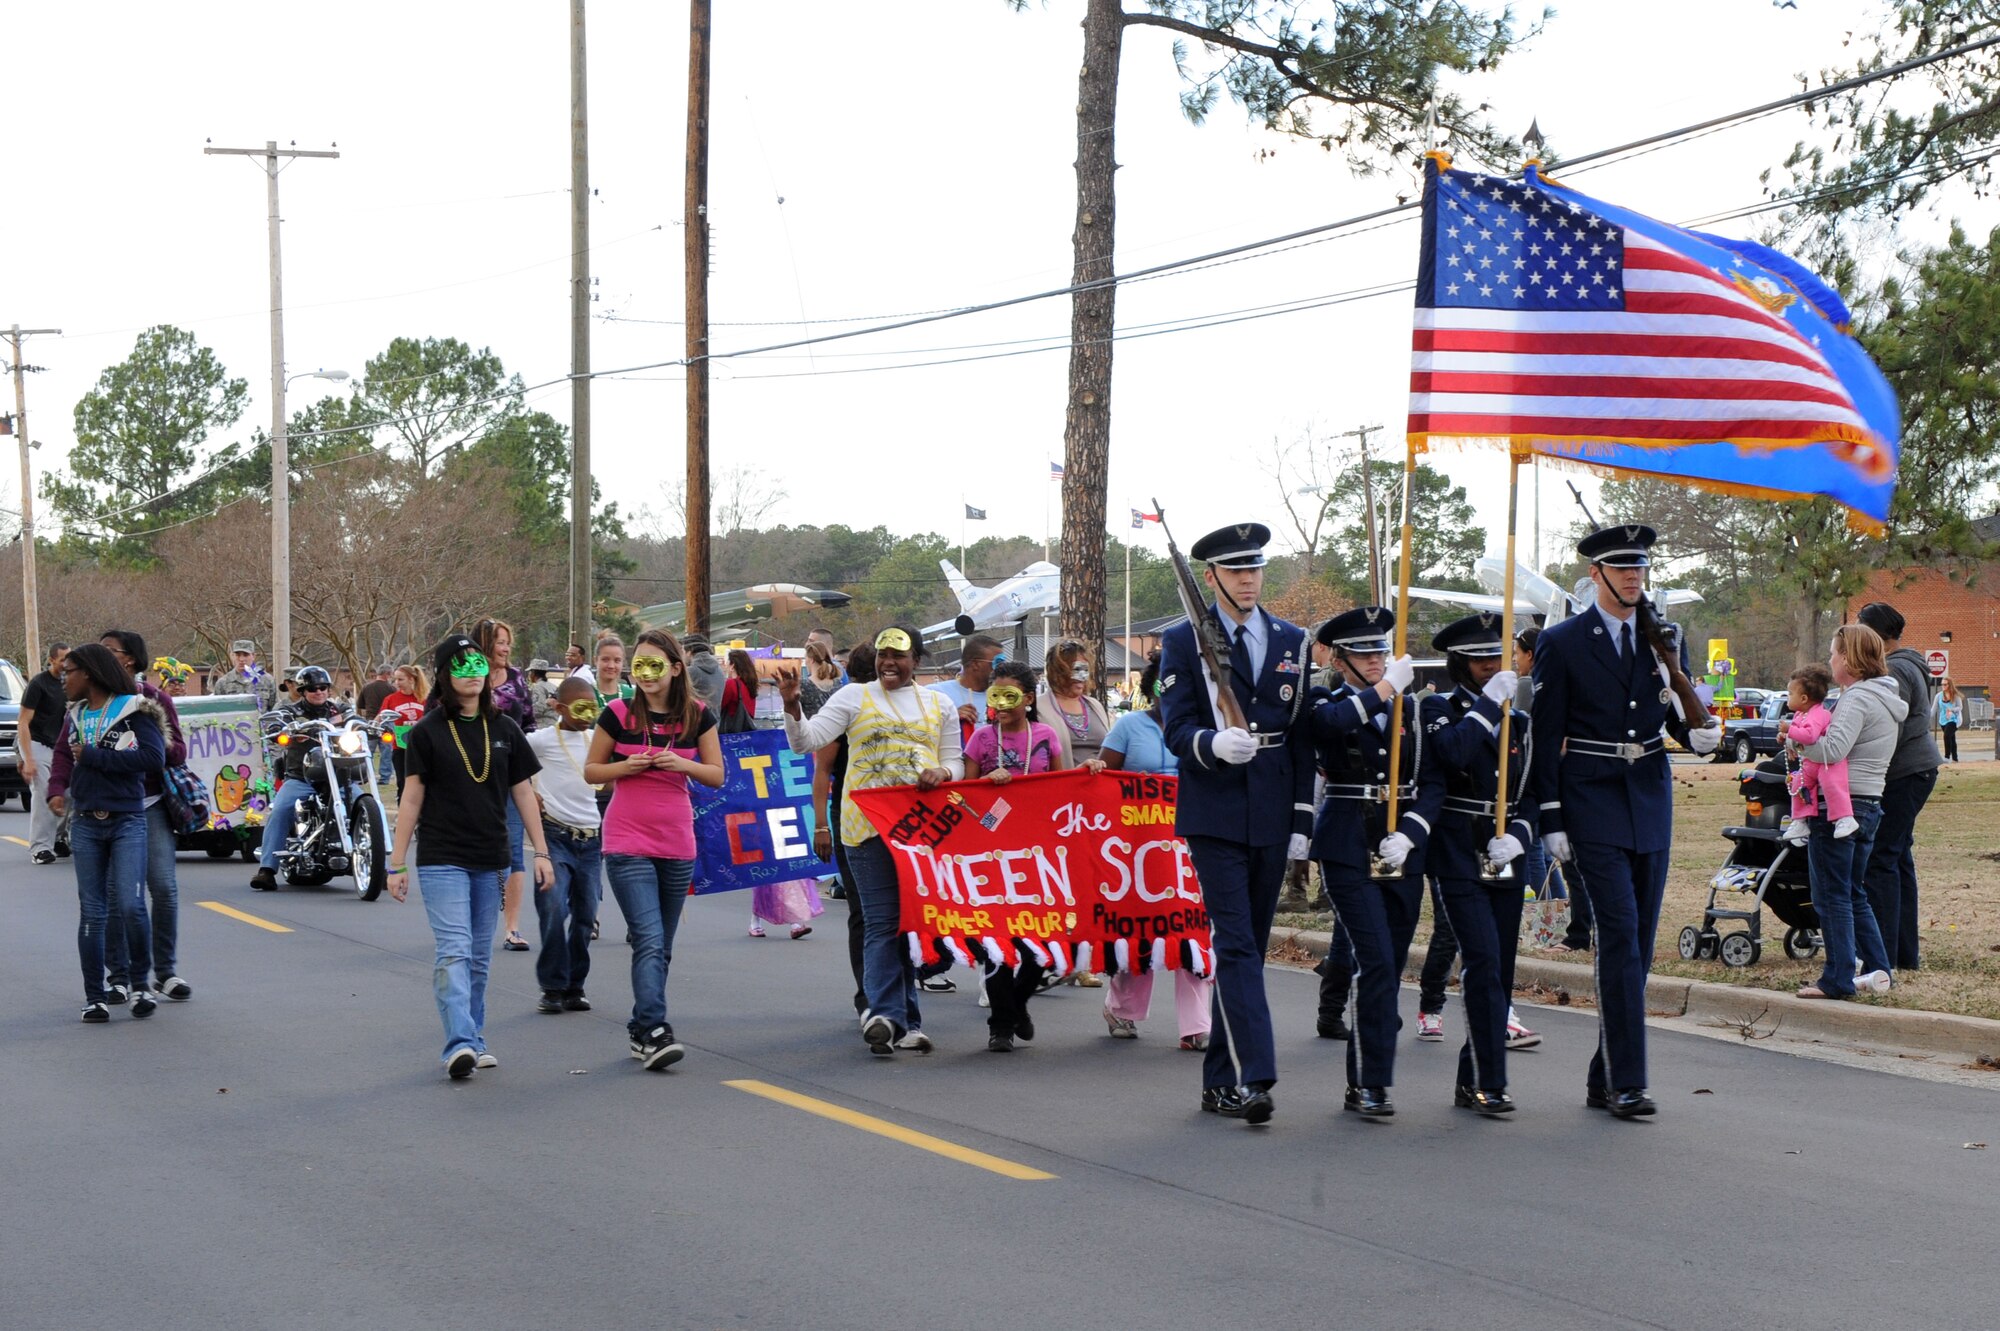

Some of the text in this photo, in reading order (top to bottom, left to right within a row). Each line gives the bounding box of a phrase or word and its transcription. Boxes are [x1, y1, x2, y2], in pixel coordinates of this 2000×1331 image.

[188, 722, 253, 759] AMDS
[1119, 779, 1176, 803] WISE
[920, 804, 963, 850] CLUB
[1051, 802, 1112, 837] The
[890, 839, 1077, 907] TWEEN
[923, 904, 1063, 938] POWER HOUR
